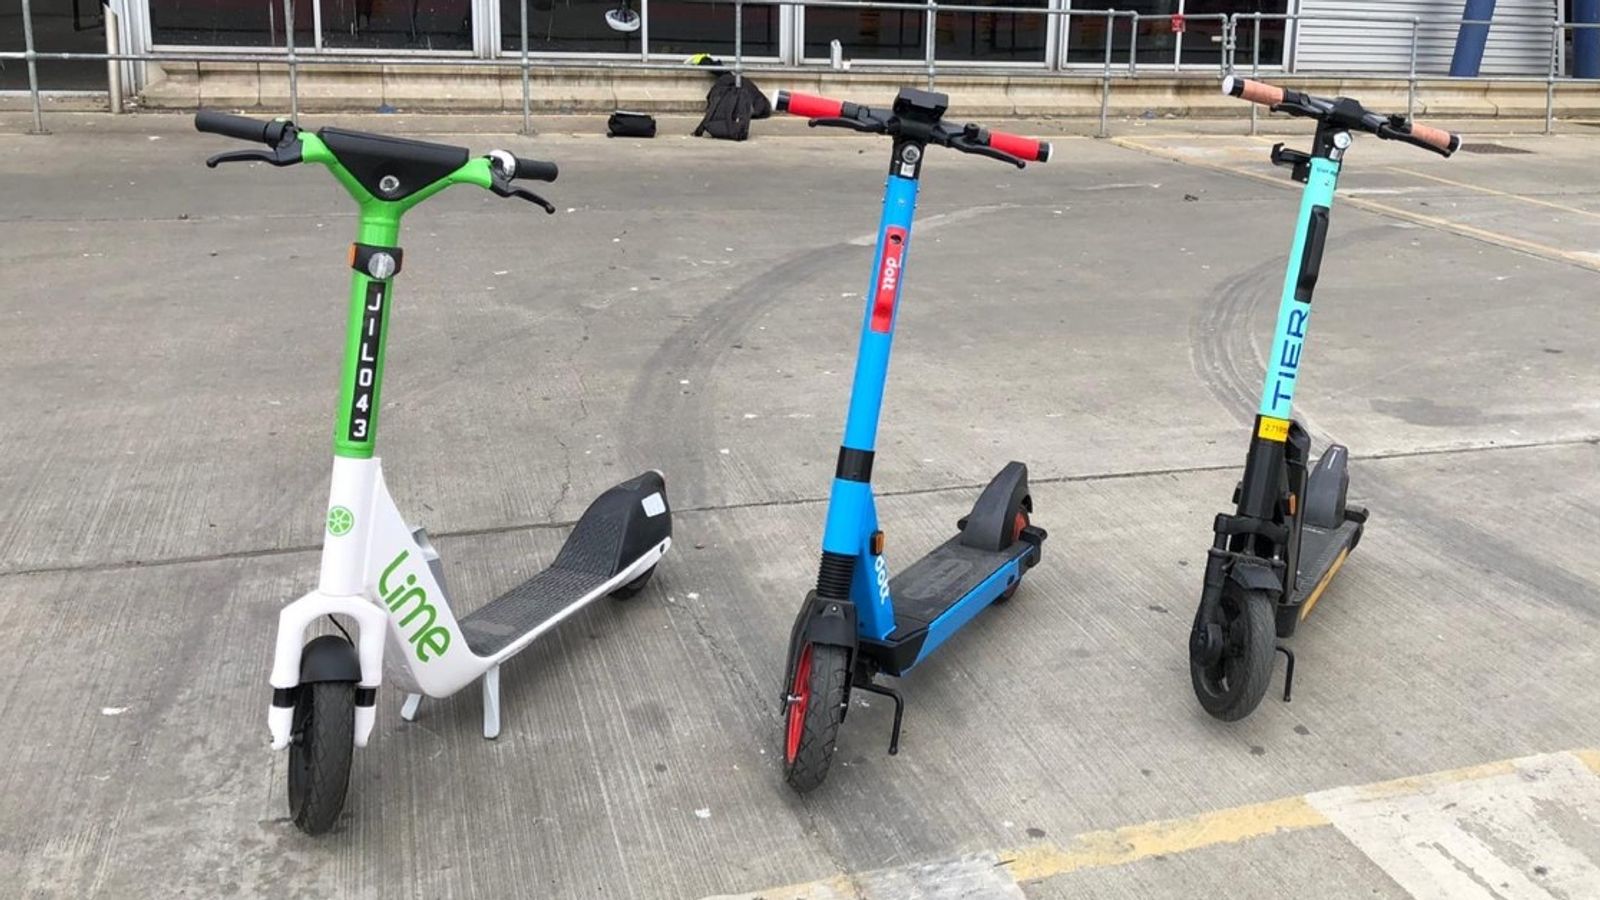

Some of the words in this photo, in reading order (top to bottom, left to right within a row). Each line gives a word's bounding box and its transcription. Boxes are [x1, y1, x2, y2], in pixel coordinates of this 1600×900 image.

[881, 257, 900, 290] dott
[1272, 309, 1308, 410] TIER
[379, 550, 450, 663] Lime
